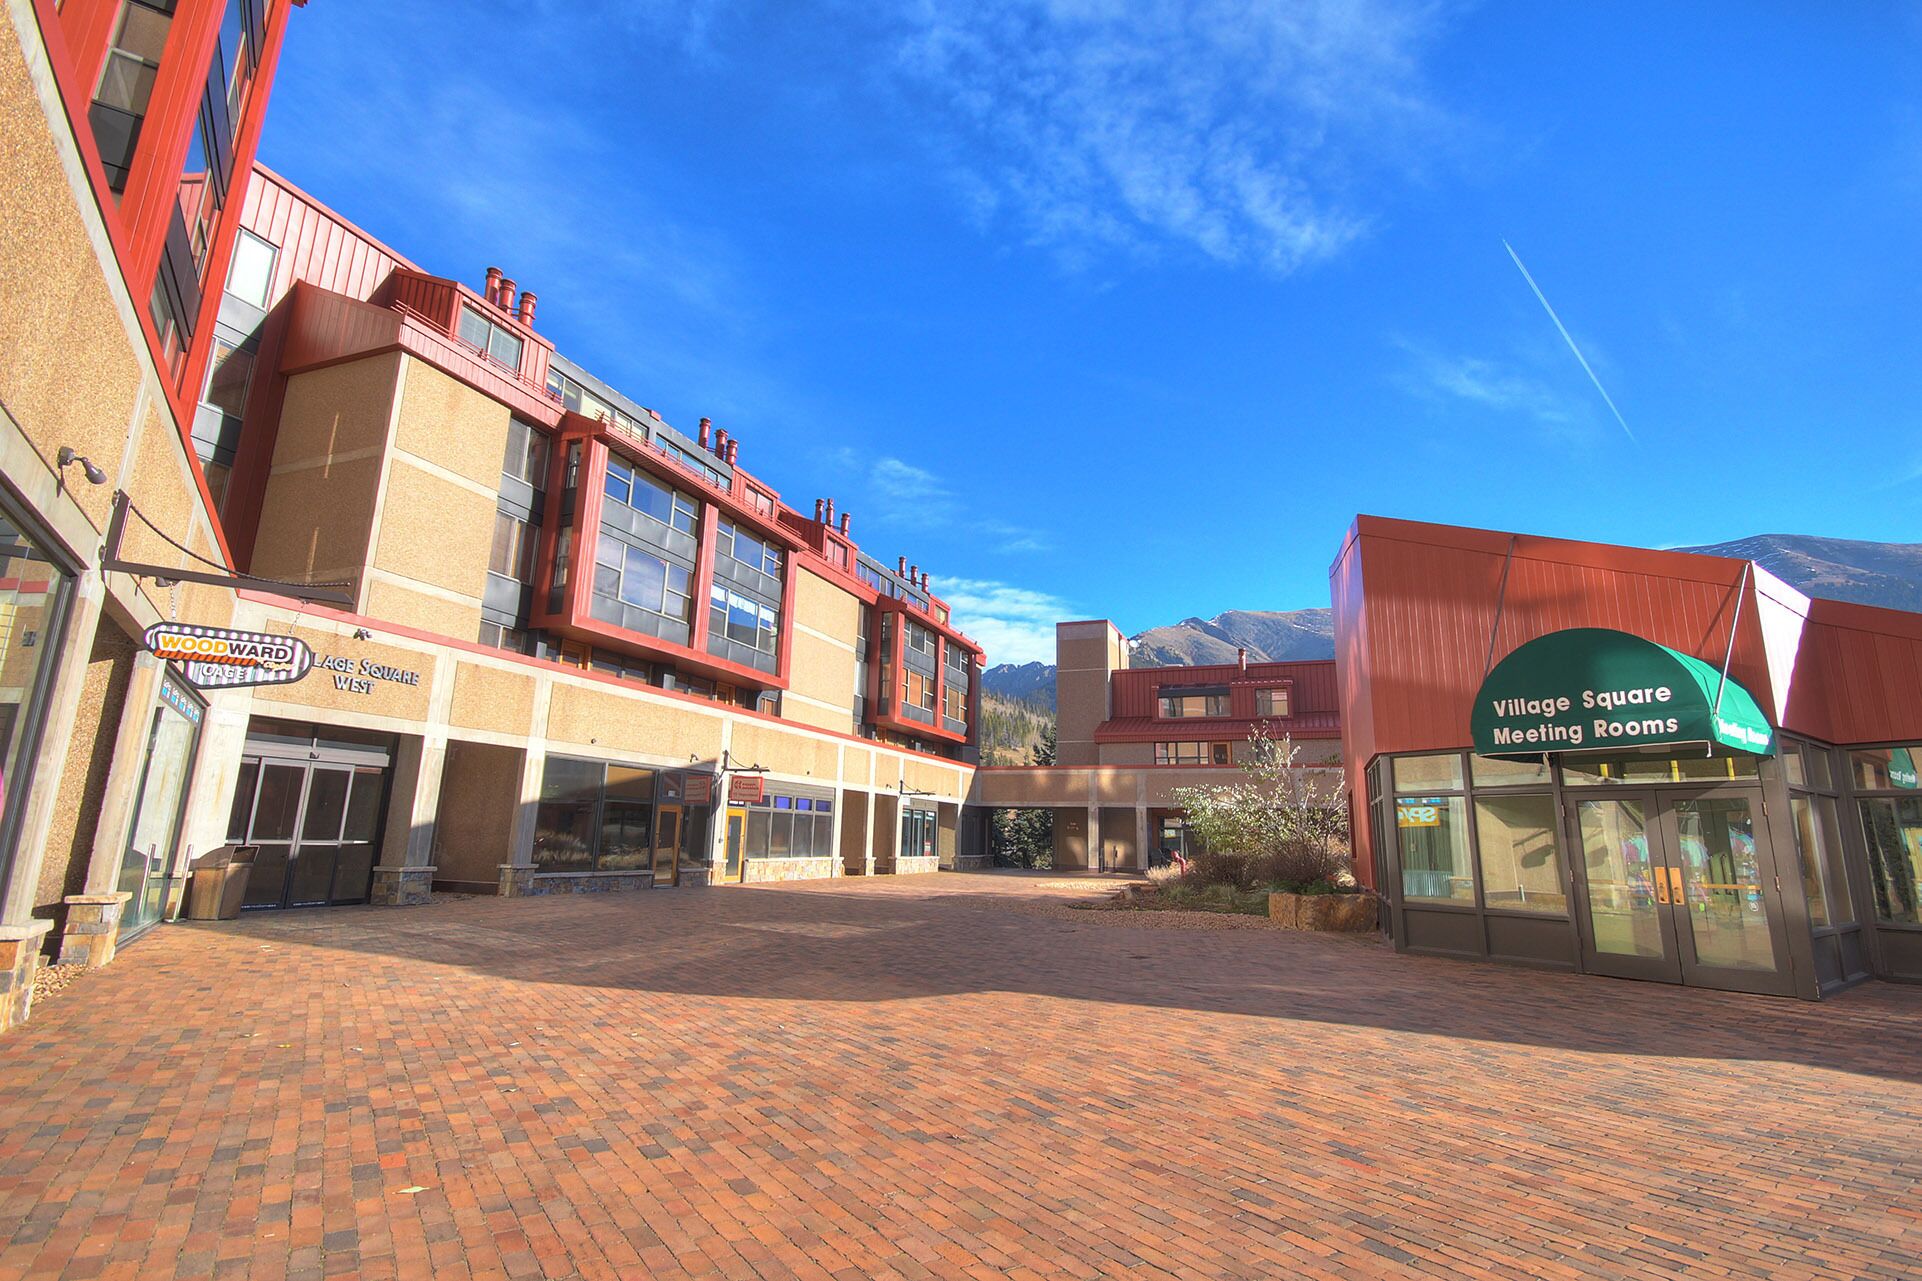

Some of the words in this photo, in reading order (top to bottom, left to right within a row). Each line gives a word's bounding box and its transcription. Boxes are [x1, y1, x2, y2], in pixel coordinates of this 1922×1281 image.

[161, 634, 289, 661] WOODWARD
[312, 652, 355, 675] LAGE
[359, 657, 420, 686] SQUARE
[333, 673, 376, 695] WEST
[1492, 696, 1571, 718] Village
[1582, 686, 1672, 711] Square
[1493, 723, 1583, 745] Meeting
[1593, 717, 1678, 738] Rooms
